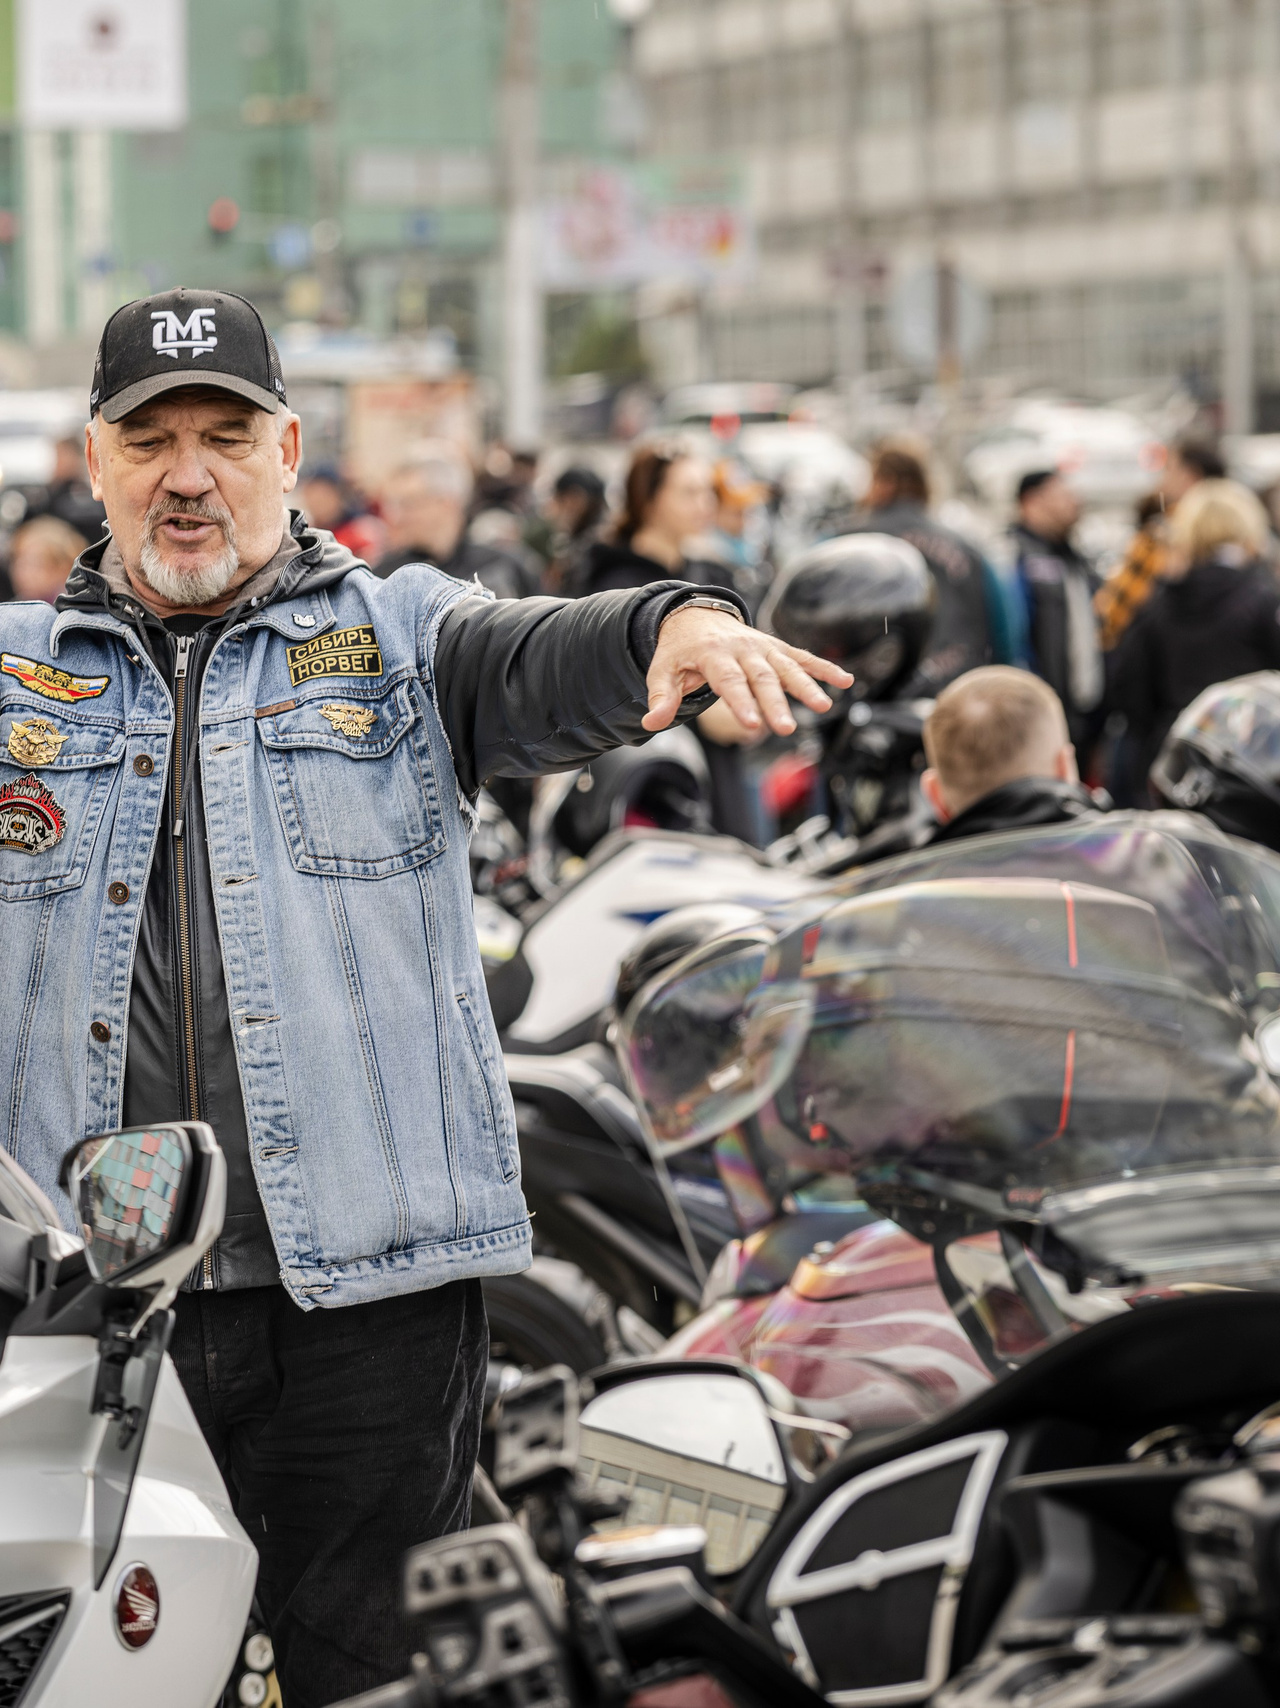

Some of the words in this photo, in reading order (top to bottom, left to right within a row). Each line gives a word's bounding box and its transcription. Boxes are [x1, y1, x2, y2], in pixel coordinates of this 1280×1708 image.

[295, 629, 373, 660] СИБИРЬ
[297, 654, 373, 679] НОРВЕГ
[13, 785, 41, 800] 2000
